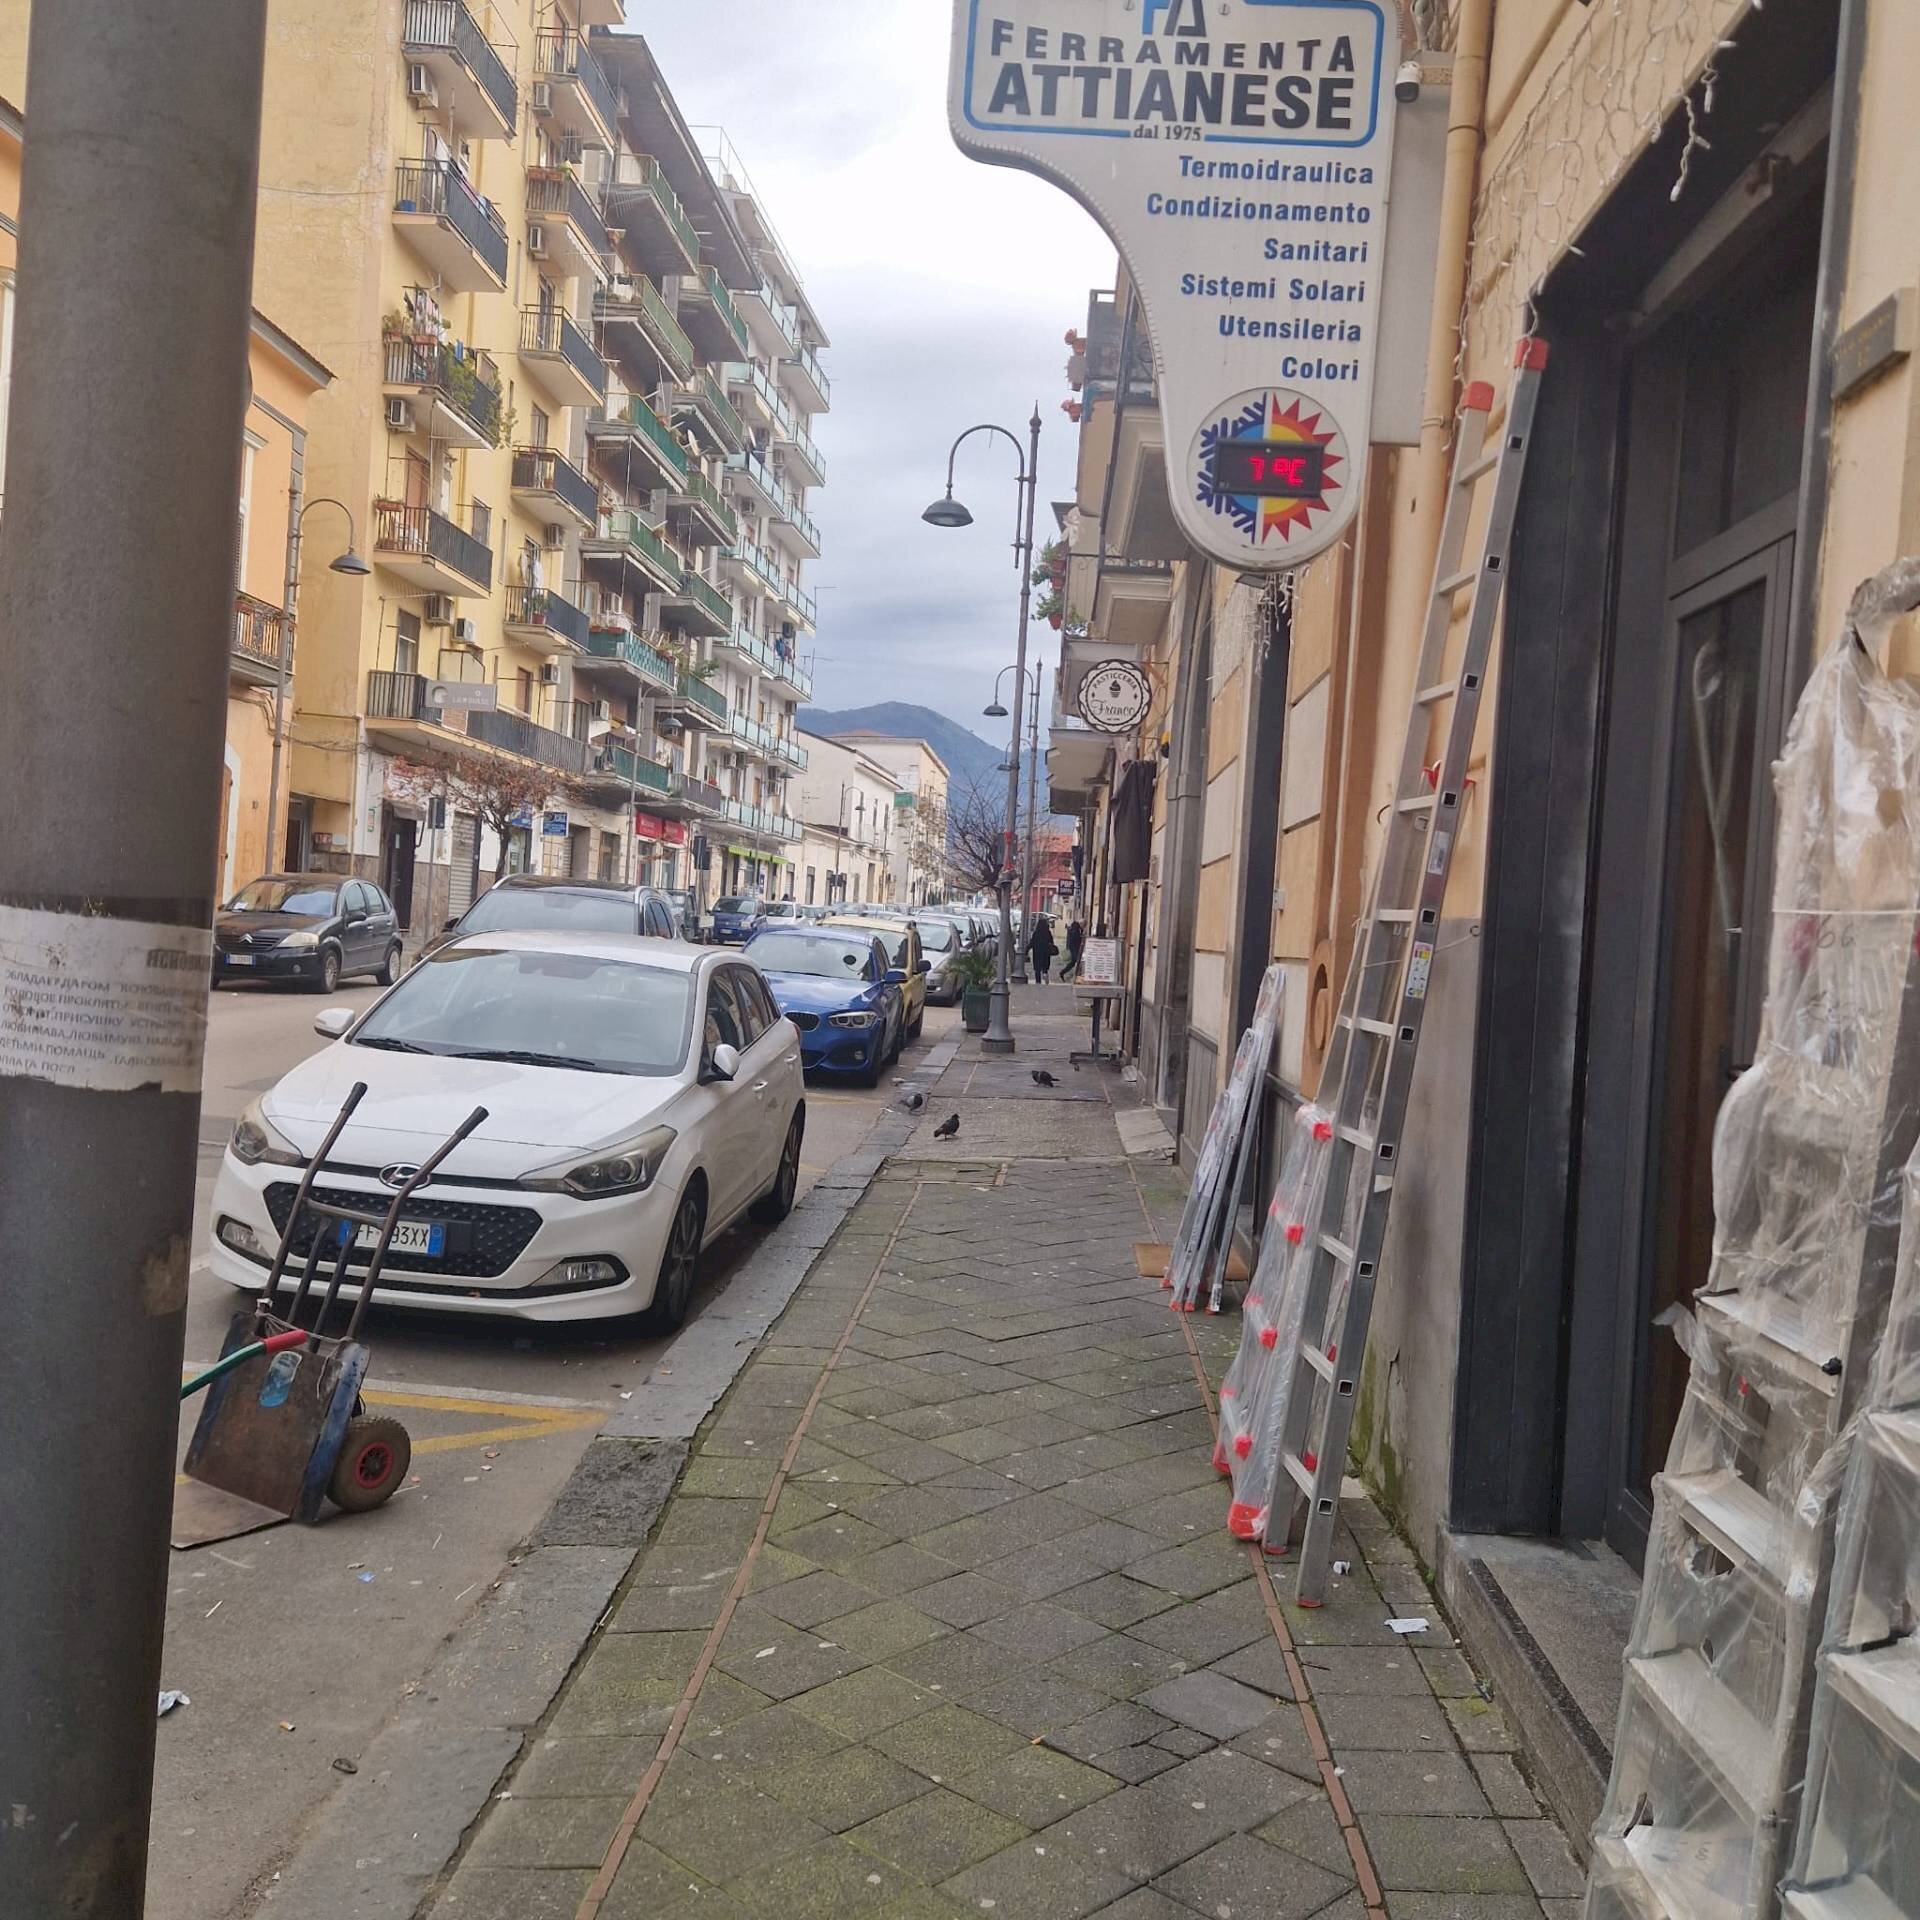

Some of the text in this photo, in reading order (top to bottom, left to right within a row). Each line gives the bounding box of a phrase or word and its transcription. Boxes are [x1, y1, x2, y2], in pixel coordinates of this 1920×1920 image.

[991, 19, 1355, 72] FERRAMENTA
[988, 62, 1354, 131] ATTIANESE
[1133, 124, 1201, 141] dal 1975
[1179, 155, 1374, 185] Termoidraulica
[1147, 193, 1371, 225] Condizionamento
[1264, 238, 1368, 263] Sanitari
[1180, 273, 1365, 303] Sistemi Solari
[1219, 315, 1362, 342] Utensileria
[1281, 356, 1359, 381] Colori
[1092, 672, 1137, 689] PASTICCERIA
